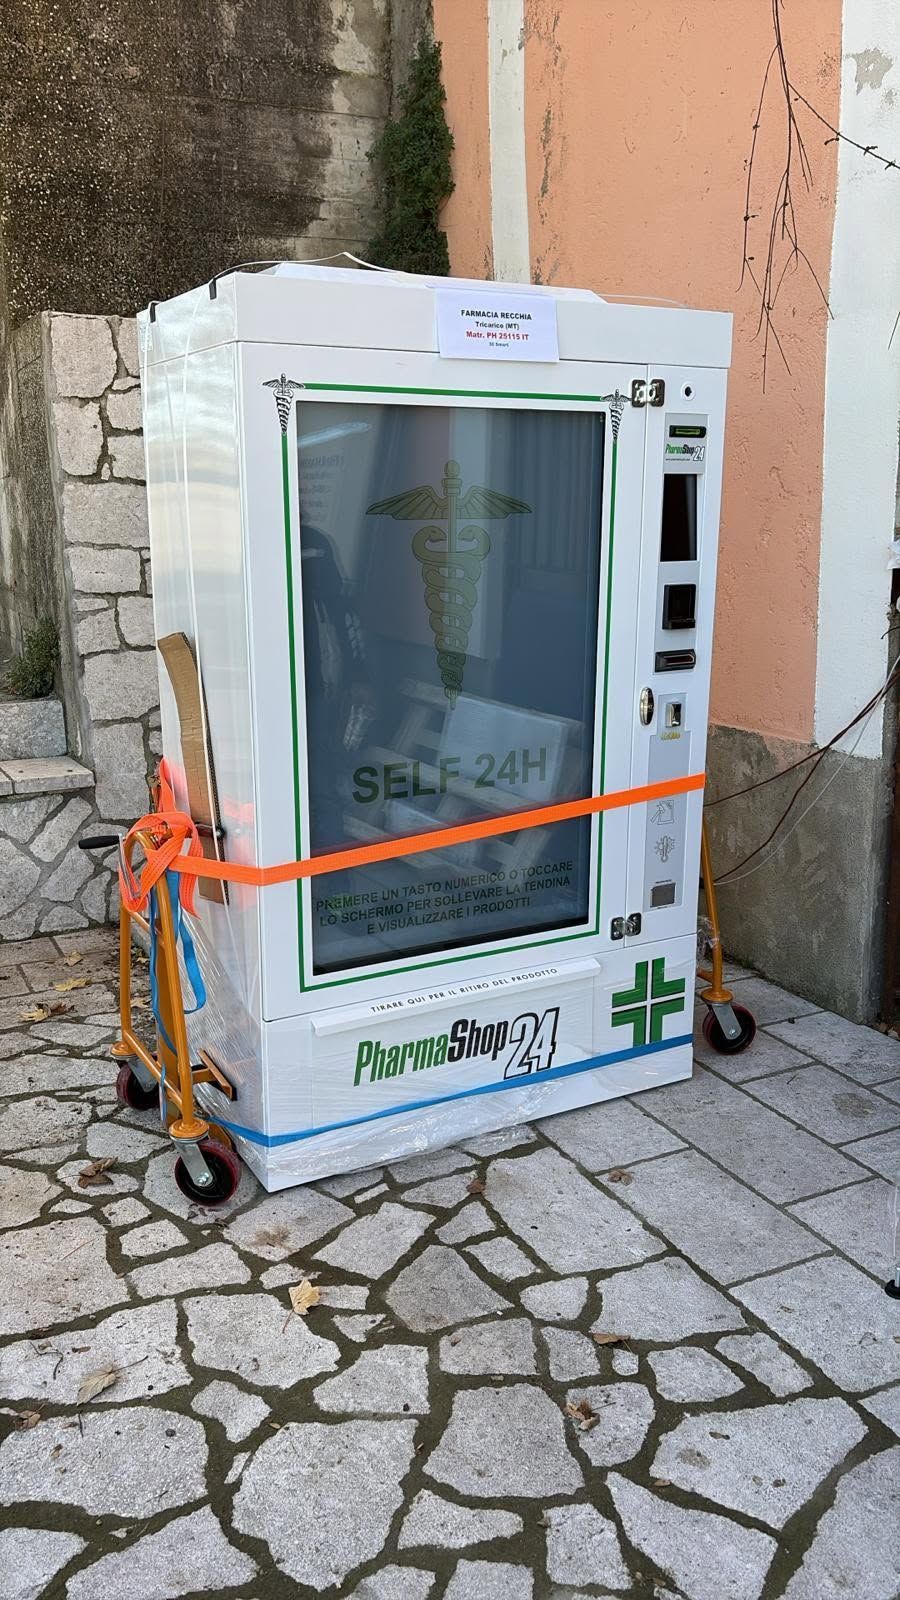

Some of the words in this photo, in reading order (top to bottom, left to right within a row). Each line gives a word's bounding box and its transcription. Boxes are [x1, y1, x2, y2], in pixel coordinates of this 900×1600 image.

[461, 309, 499, 318] FARMACIA
[500, 312, 532, 320] RECCHIA
[352, 756, 461, 804] SELF
[474, 748, 547, 788] 24H
[316, 892, 378, 912] PREMERE
[382, 888, 399, 901] UN
[402, 882, 442, 897] TASTO
[445, 872, 506, 890] NUMERICO
[509, 870, 518, 880] O
[521, 861, 574, 878] TOCCARE
[320, 914, 337, 927] LO
[341, 903, 404, 924] SCHERMO
[407, 899, 431, 912] PER
[434, 886, 503, 908] SOLLEVARE
[506, 884, 520, 895] LA
[524, 876, 570, 892] TENDINA
[367, 924, 375, 934] E
[378, 906, 464, 932] VISUALIZZARE
[472, 897, 530, 917] PRODOTTI
[370, 1000, 403, 1013] TIRARE
[407, 996, 426, 1005] QUI
[429, 992, 445, 1000] PER
[459, 982, 489, 994] RITIRO
[492, 979, 508, 987] DEL
[511, 968, 558, 982] PRODOTTO
